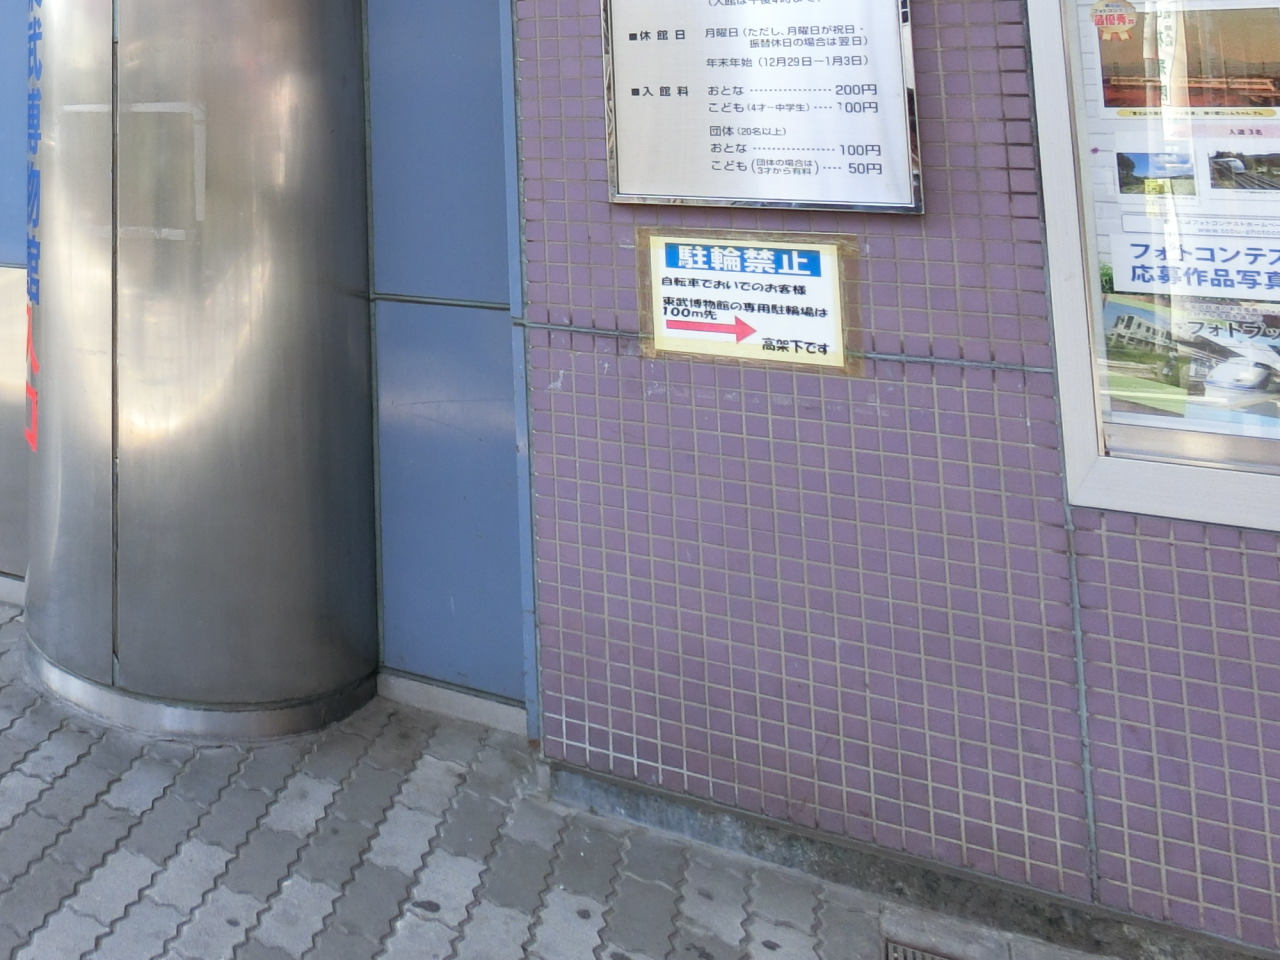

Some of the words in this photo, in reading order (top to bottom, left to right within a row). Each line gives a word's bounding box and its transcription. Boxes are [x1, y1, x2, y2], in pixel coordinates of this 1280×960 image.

[642, 86, 689, 97] 入館料
[708, 86, 744, 96] おとな
[835, 84, 878, 96] 200円
[710, 143, 747, 154] おとな
[839, 144, 881, 156] 100円
[712, 161, 748, 172] こども
[848, 163, 883, 175] 50円
[678, 245, 811, 275] 駐輪禁止
[661, 276, 807, 296] 自転車でおいでのお客様
[662, 296, 828, 318] 東武博物館の専用駐輪場は
[662, 306, 718, 321] 100m先
[762, 337, 830, 356] 高架下です
